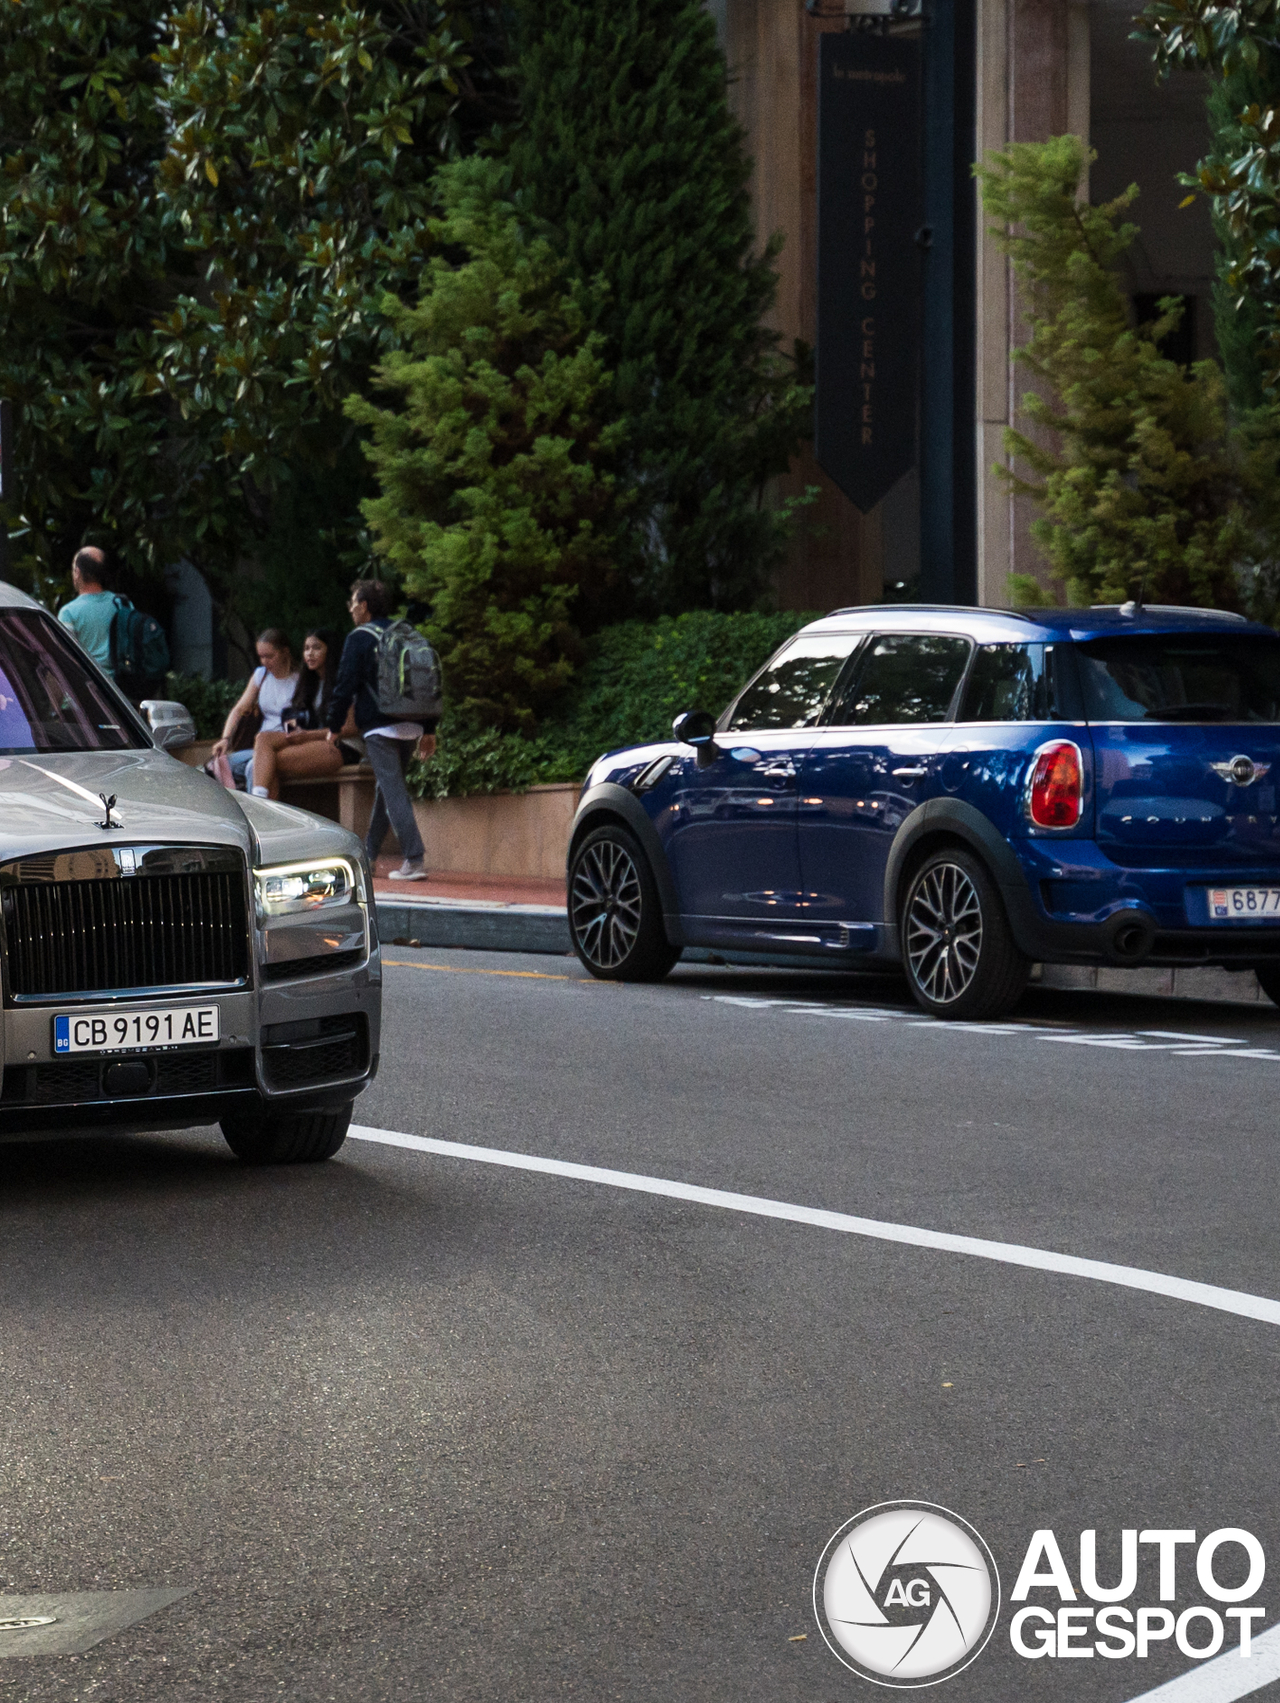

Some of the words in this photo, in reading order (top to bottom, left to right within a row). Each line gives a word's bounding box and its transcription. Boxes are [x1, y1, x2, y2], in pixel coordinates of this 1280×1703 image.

[861, 129, 878, 300] SHOPPING
[861, 317, 876, 445] CENTER
[1233, 890, 1280, 911] 6877
[57, 1038, 69, 1047] BG
[74, 1019, 108, 1046] CB
[113, 1014, 173, 1044] 9191
[182, 1010, 214, 1039] AE
